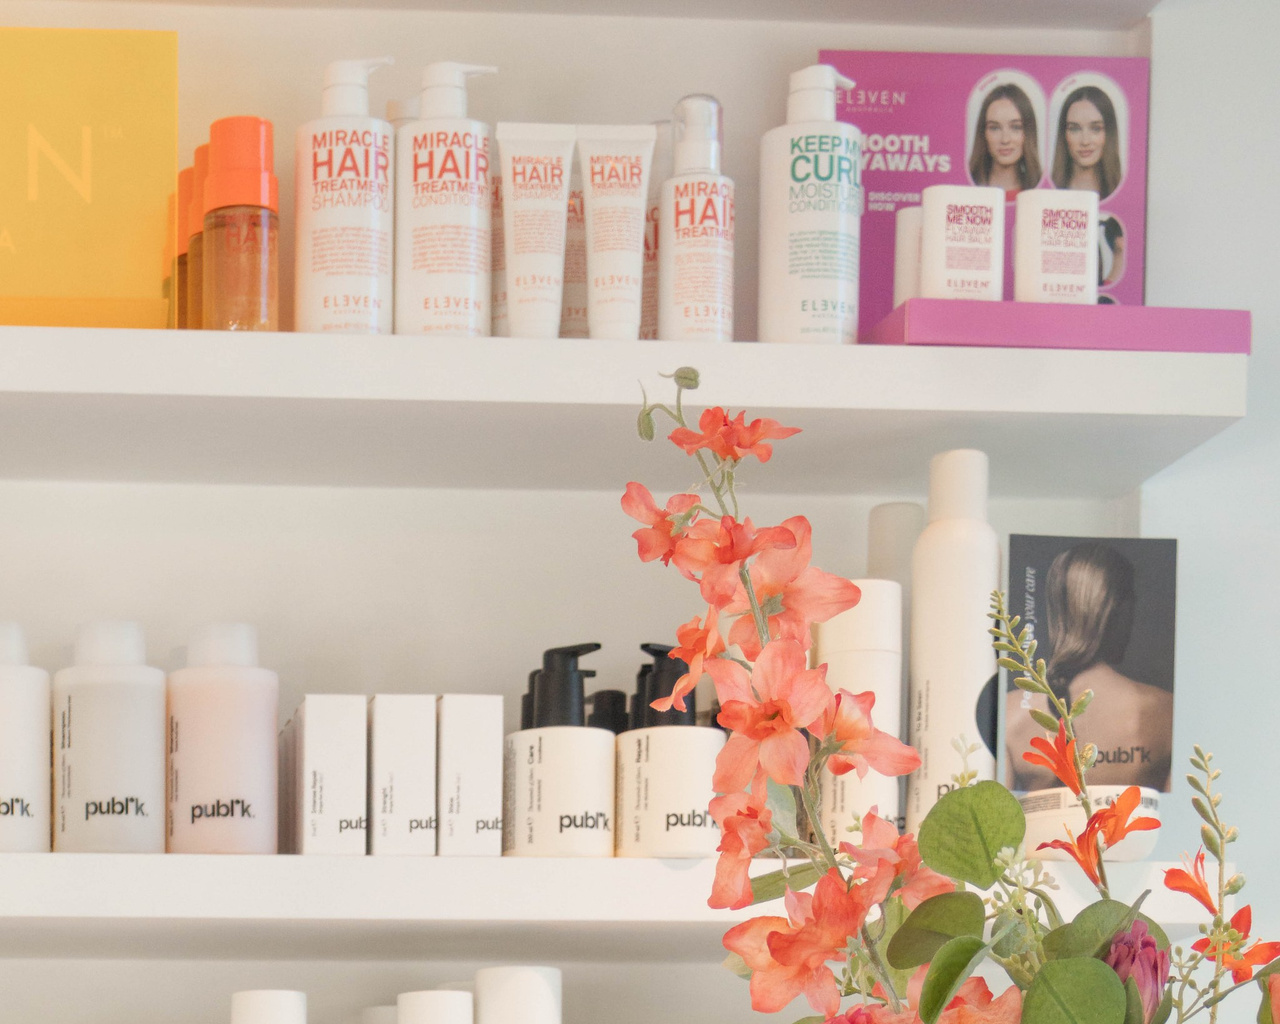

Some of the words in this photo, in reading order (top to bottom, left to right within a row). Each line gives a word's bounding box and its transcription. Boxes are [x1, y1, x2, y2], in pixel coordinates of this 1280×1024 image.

[312, 130, 389, 152] MIRACLE
[413, 131, 489, 152] MIRACLE
[790, 135, 842, 154] KEEP
[312, 147, 389, 182] HAIR
[413, 148, 489, 182] HAIR
[512, 164, 563, 184] HAIR
